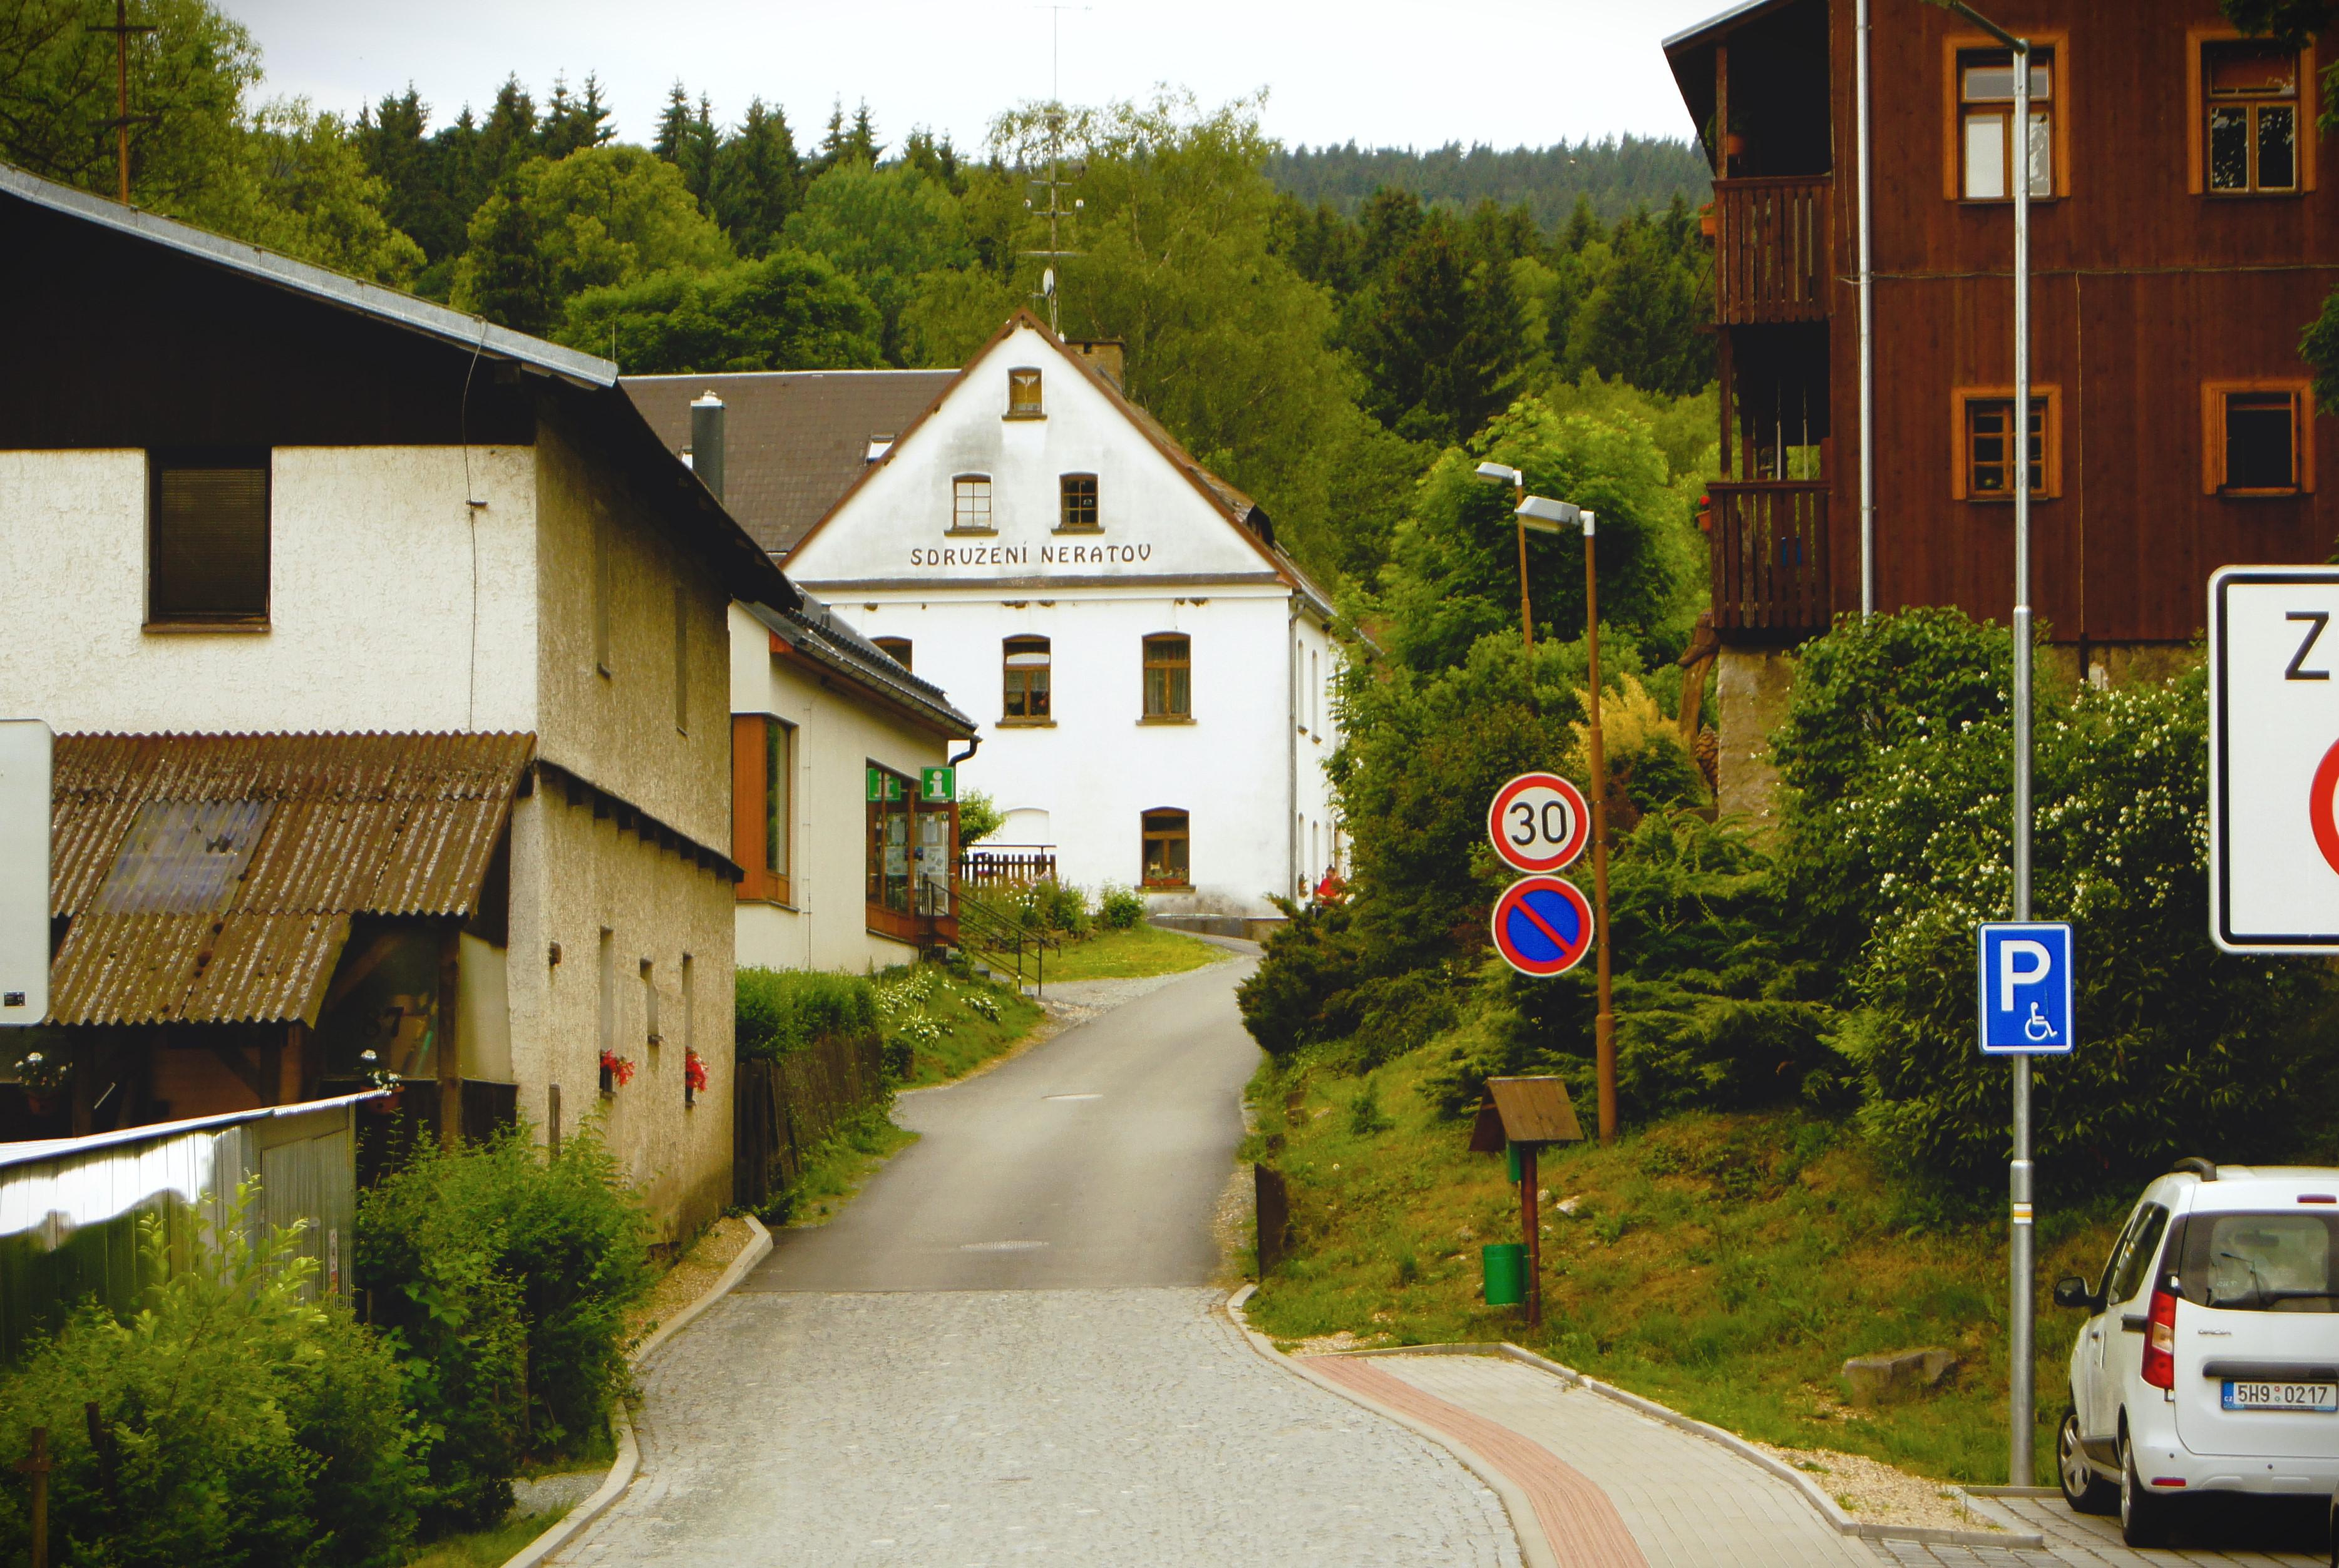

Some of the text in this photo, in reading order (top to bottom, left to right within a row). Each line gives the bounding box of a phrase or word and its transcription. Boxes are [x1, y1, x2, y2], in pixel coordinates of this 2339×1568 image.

[910, 541, 1152, 565] SDRUŽENÍ NERATOV
[1509, 800, 1568, 846] 30
[2000, 940, 2052, 1012] P
[2238, 1385, 2328, 1404] 5H9 0217
